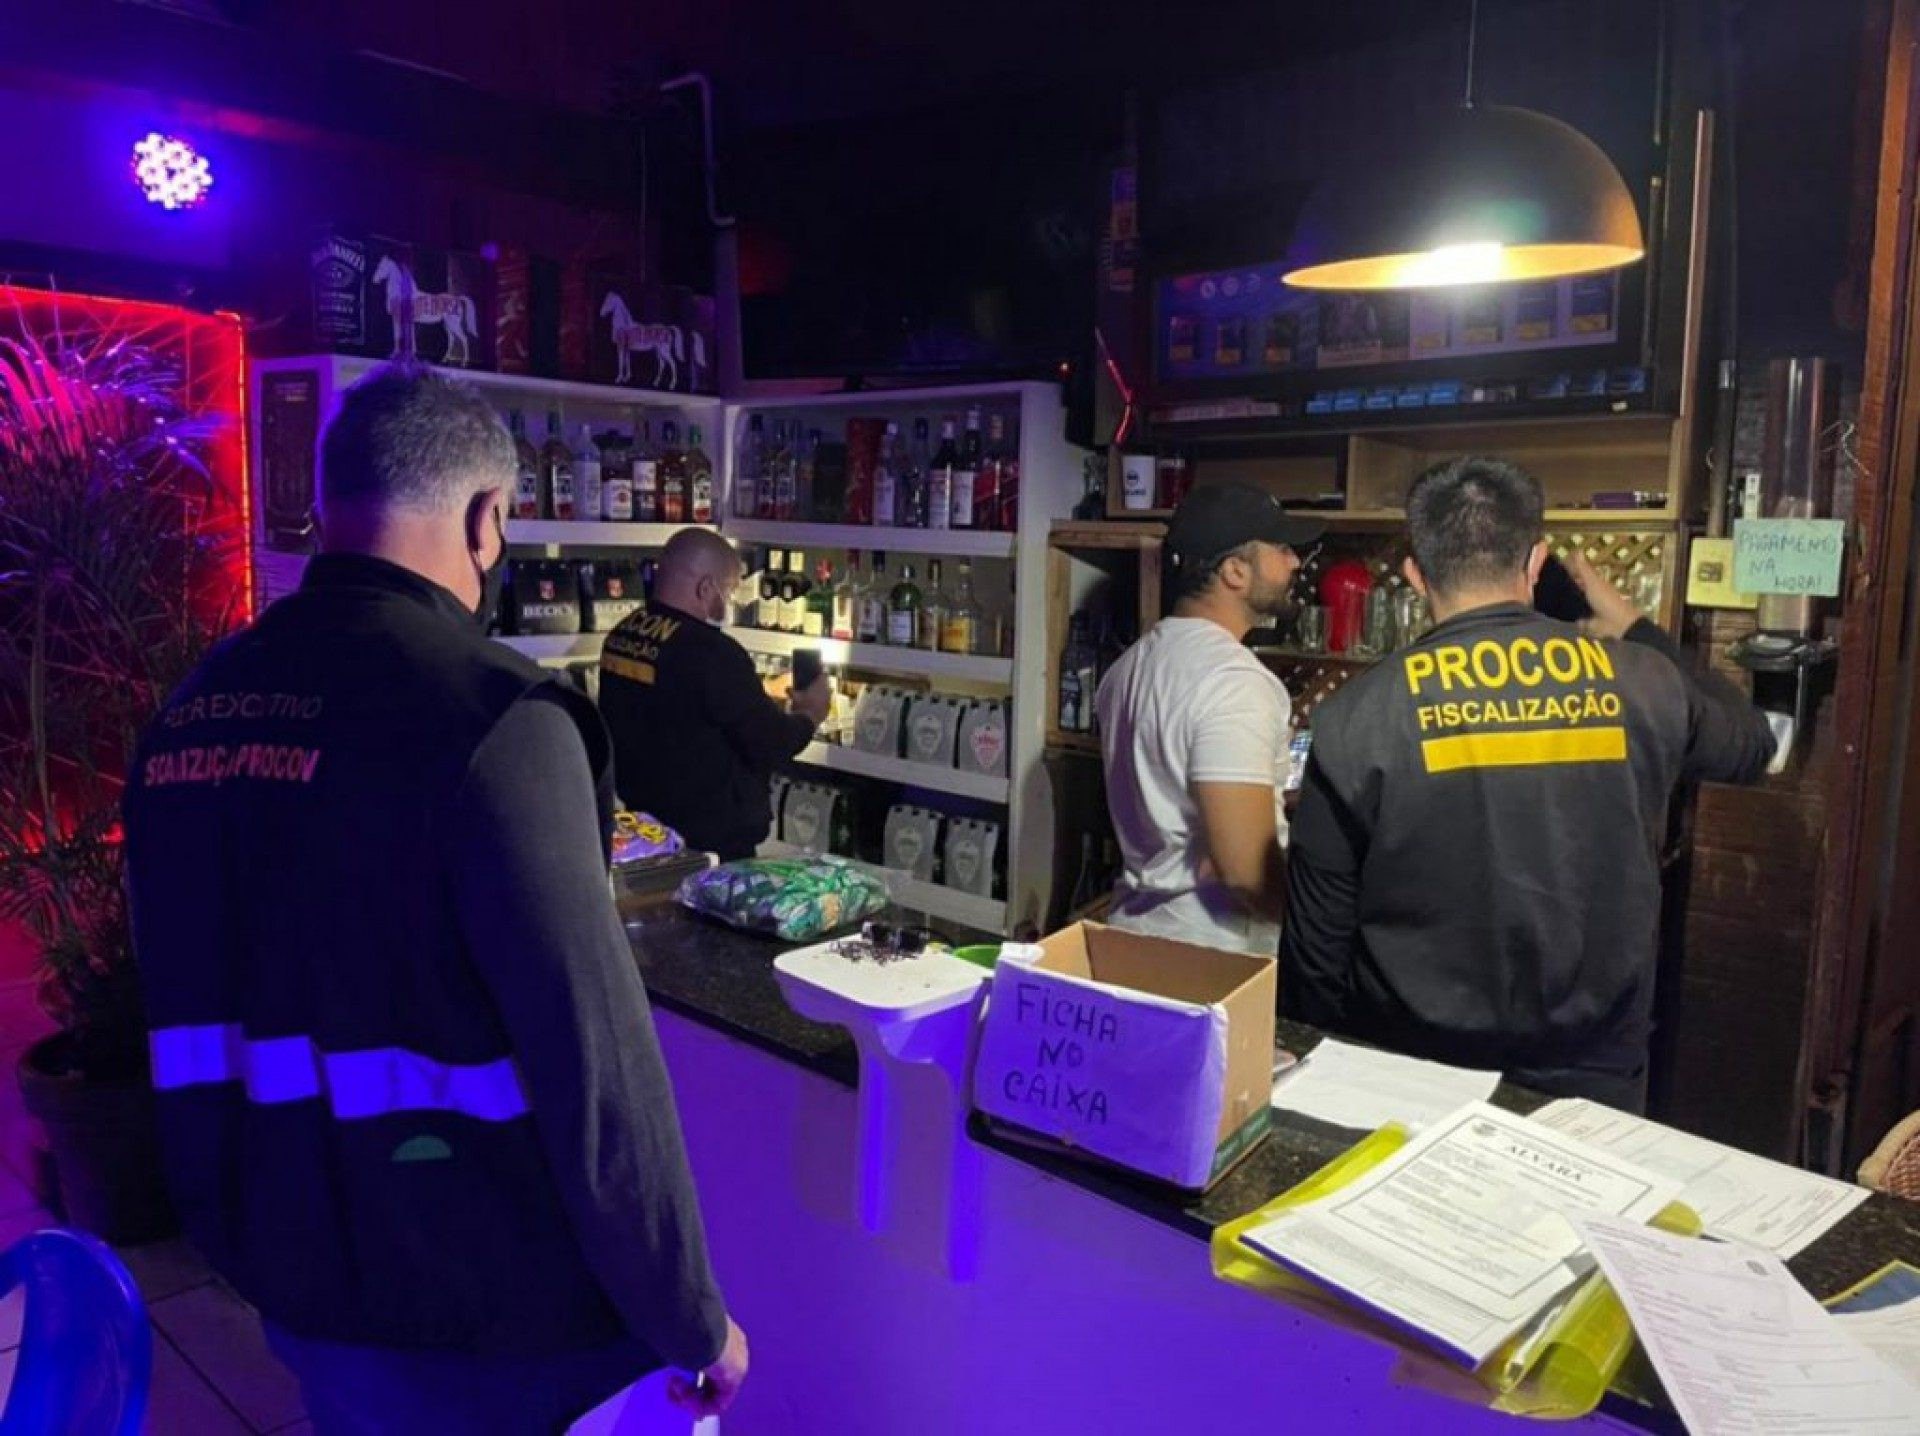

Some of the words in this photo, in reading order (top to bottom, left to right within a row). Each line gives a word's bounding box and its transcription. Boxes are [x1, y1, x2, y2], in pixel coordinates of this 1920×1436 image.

[1749, 557, 1775, 575] NA
[1404, 637, 1616, 696] PROCON
[1417, 689, 1622, 731] FISCALIZAÇÃO
[1015, 982, 1119, 1042] FICHA
[1036, 1037, 1084, 1068] NO
[1002, 1070, 1108, 1125] CAIXA
